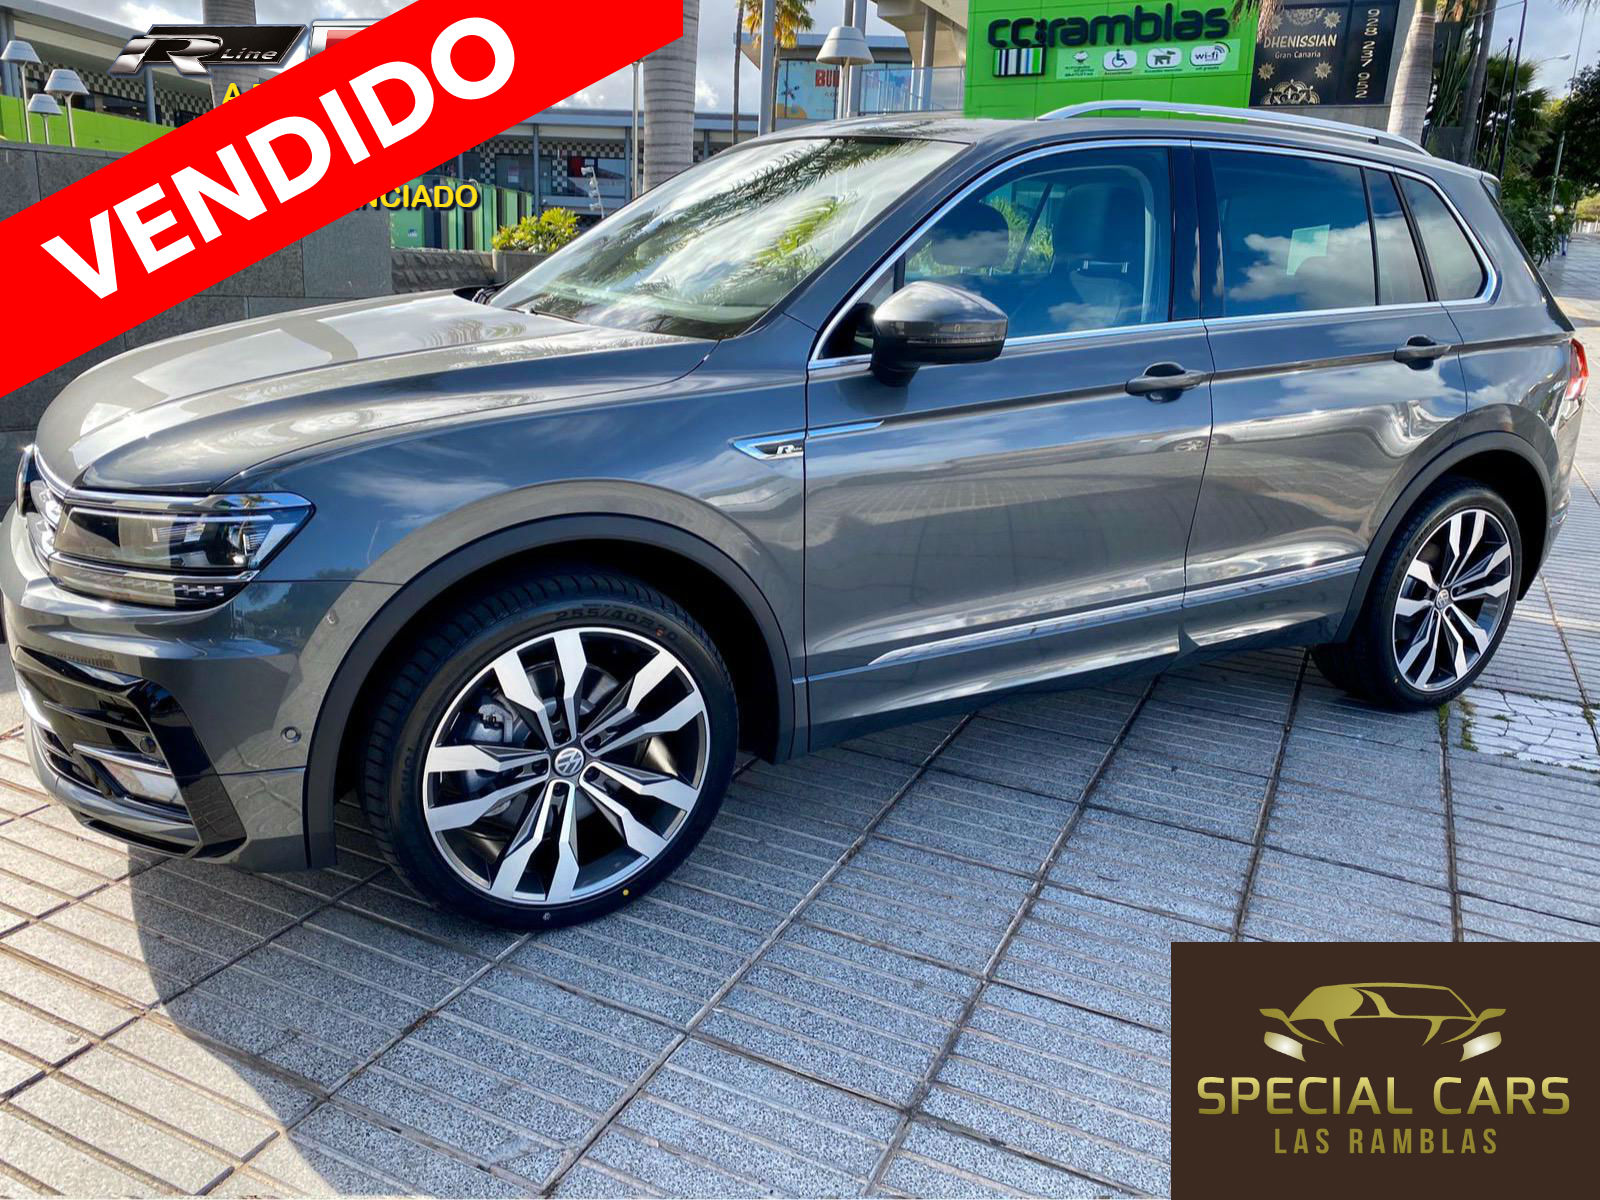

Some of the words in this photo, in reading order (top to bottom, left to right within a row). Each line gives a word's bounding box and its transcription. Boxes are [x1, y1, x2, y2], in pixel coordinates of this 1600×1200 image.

[1263, 34, 1338, 49] DHENISSIAN
[1195, 50, 1219, 61] wi-fi
[1274, 51, 1292, 59] Gran
[1293, 50, 1321, 58] Canaria
